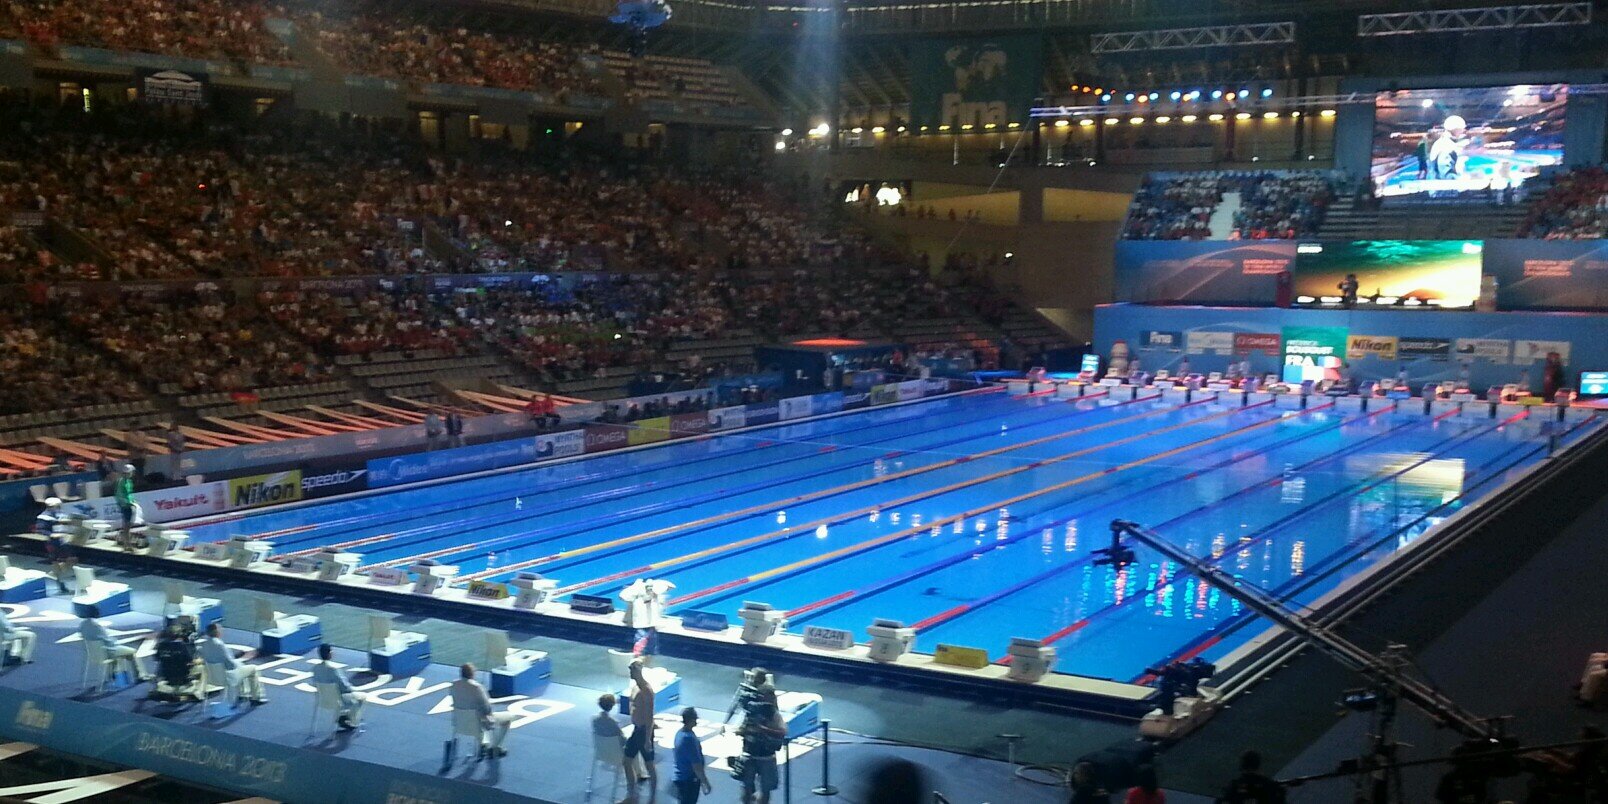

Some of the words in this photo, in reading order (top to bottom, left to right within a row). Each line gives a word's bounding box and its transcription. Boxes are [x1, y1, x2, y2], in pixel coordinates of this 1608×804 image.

[1352, 338, 1393, 351] Nikon
[597, 430, 626, 445] OMEGA
[301, 470, 349, 490] speedo
[153, 491, 209, 511] Yakult
[234, 478, 296, 507] Nikon
[471, 585, 501, 598] Nikon
[808, 627, 846, 641] KAZAN
[137, 731, 237, 773] BARCELONA
